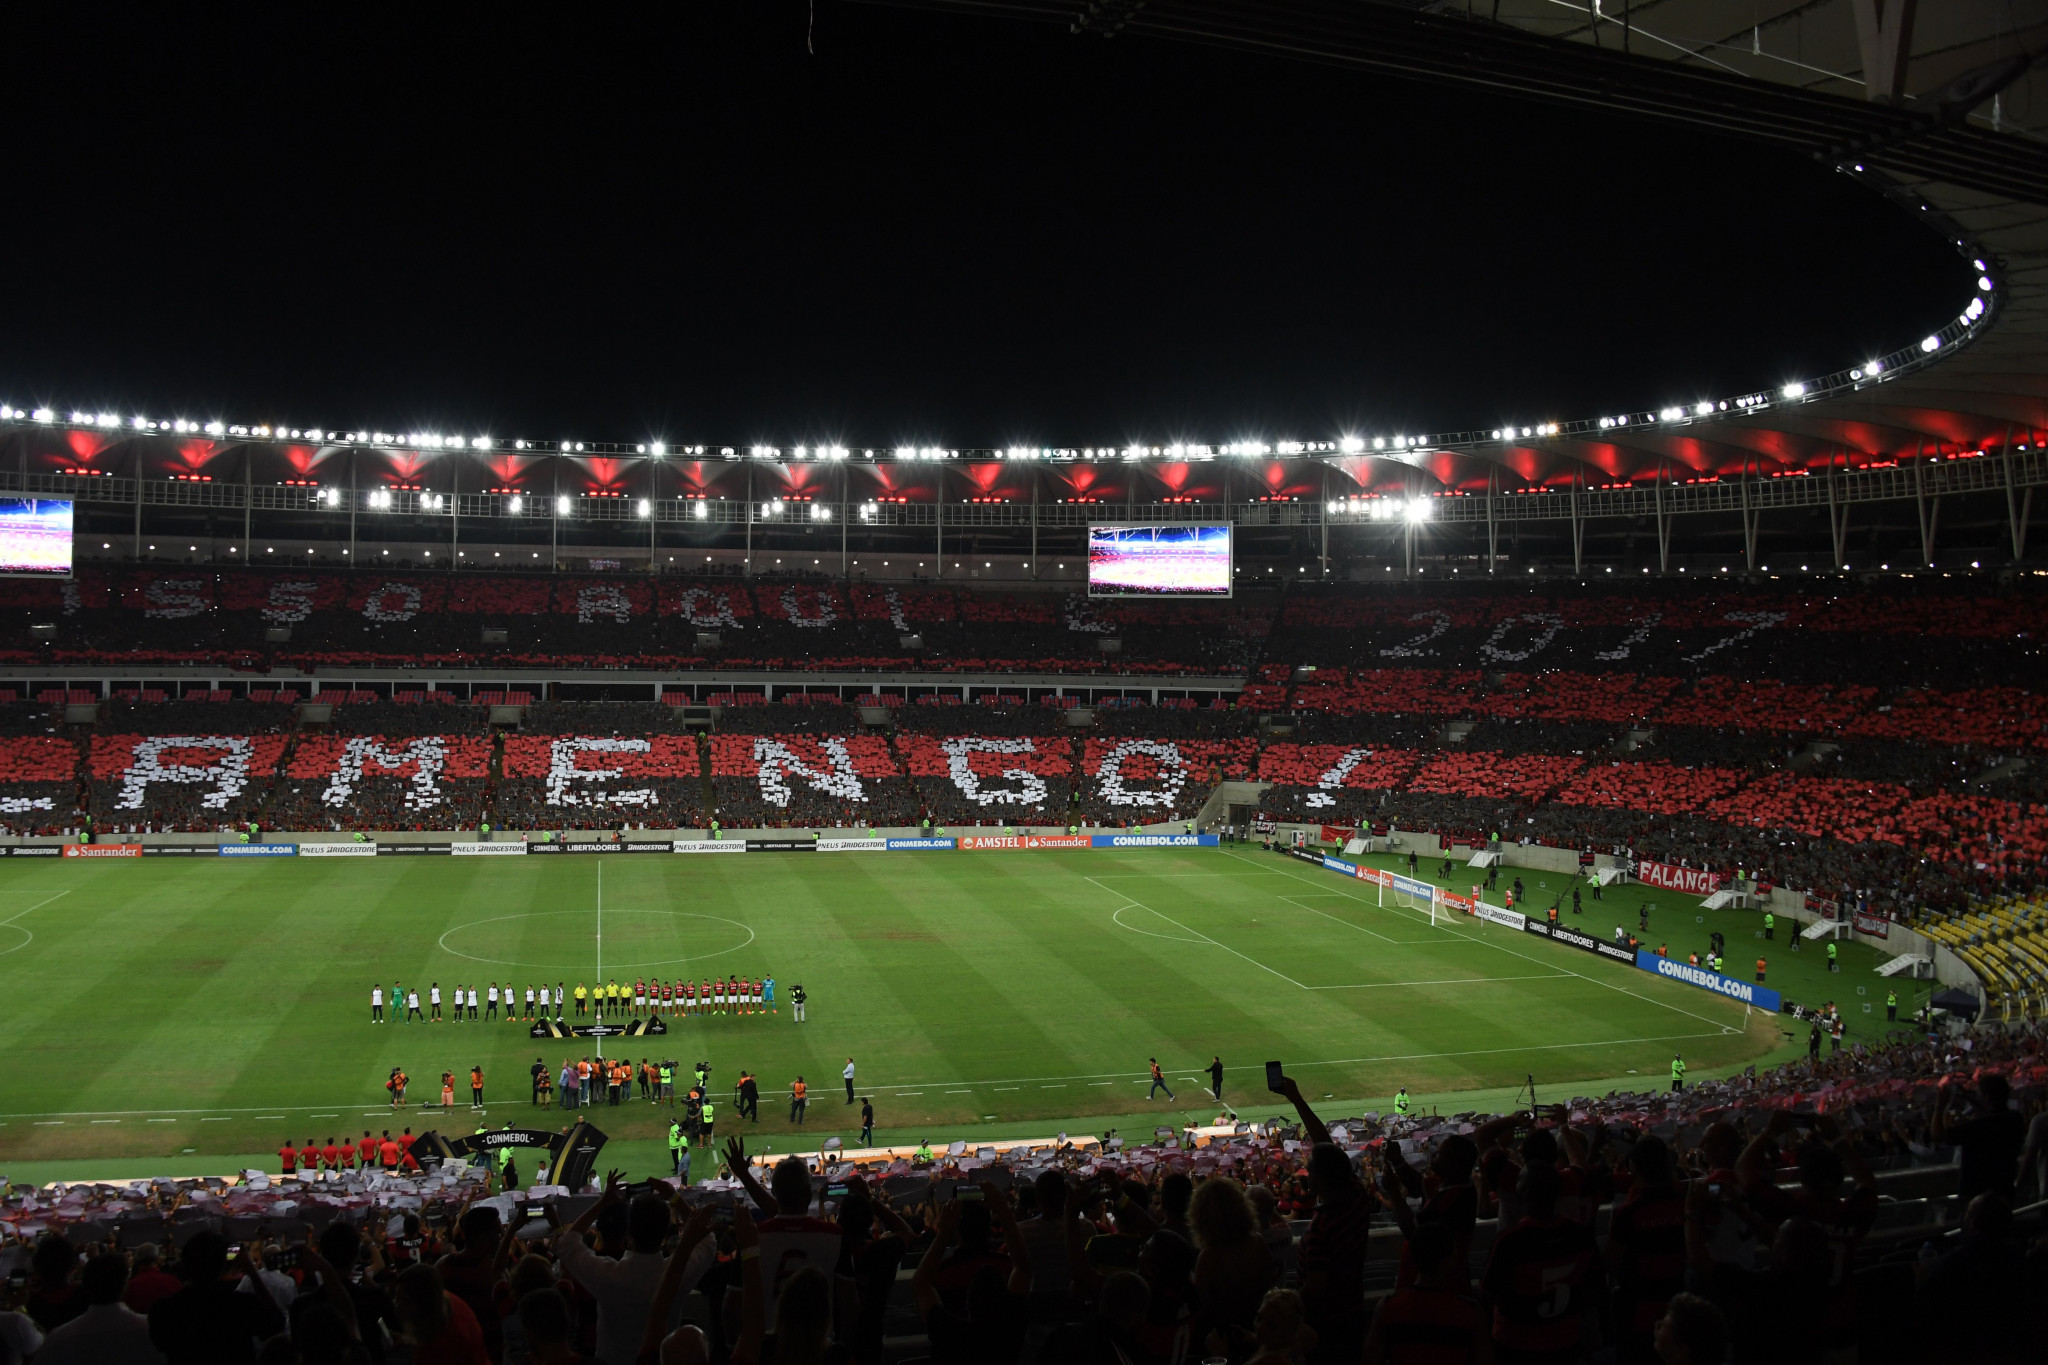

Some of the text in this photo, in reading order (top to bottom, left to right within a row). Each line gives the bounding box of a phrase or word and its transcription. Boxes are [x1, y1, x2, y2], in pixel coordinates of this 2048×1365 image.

[1380, 610, 1788, 664] 2017
[841, 841, 886, 849] BRIDGESTONE
[889, 840, 952, 848] CONMEBOL.COM
[975, 837, 1020, 848] AMSTEL
[1040, 836, 1088, 847] Santander
[1112, 836, 1199, 846] CONMEBOL.COM
[12, 847, 60, 855] BRIDGESTONE
[80, 846, 138, 857] Santander
[222, 846, 293, 854] CONMEBOL.COM
[627, 843, 671, 851] BRIDGESTONE
[1324, 858, 1356, 874] CONMEBOL.COM
[1490, 908, 1524, 926] BRIDGESTONE
[1552, 928, 1594, 949] LIBERTADORES
[1597, 942, 1635, 962] BRIDGESTONE
[1657, 958, 1753, 1002] CONMEBOL.COM
[1537, 1263, 1577, 1319] 5
